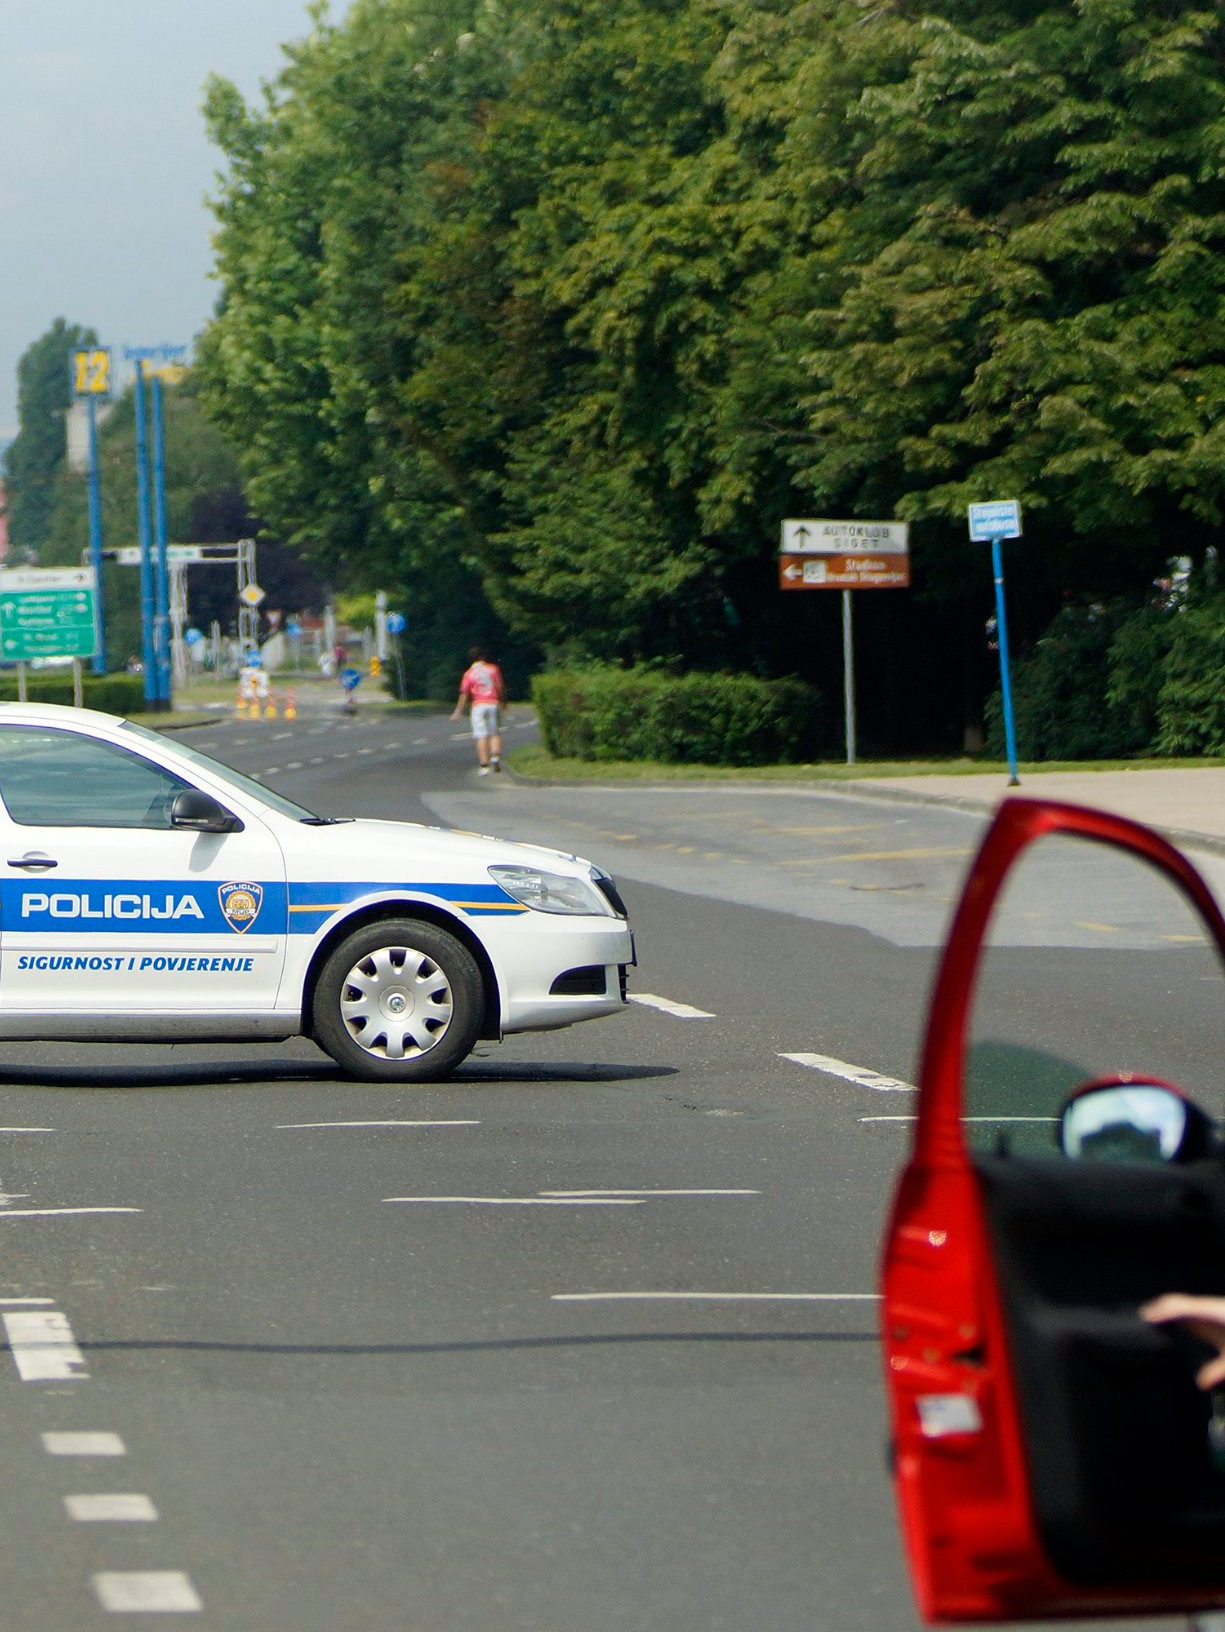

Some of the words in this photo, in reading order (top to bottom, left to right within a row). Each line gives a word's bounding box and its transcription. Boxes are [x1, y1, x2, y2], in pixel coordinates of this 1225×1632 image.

[74, 350, 109, 392] 12
[822, 525, 891, 538] AUTOKLUB
[833, 538, 879, 548] SIGET
[221, 883, 260, 895] POLICIJA
[21, 893, 204, 919] POLICIJA
[17, 956, 124, 971] SIGURNOST
[127, 957, 134, 971] I
[139, 957, 254, 972] POVJERENJE
